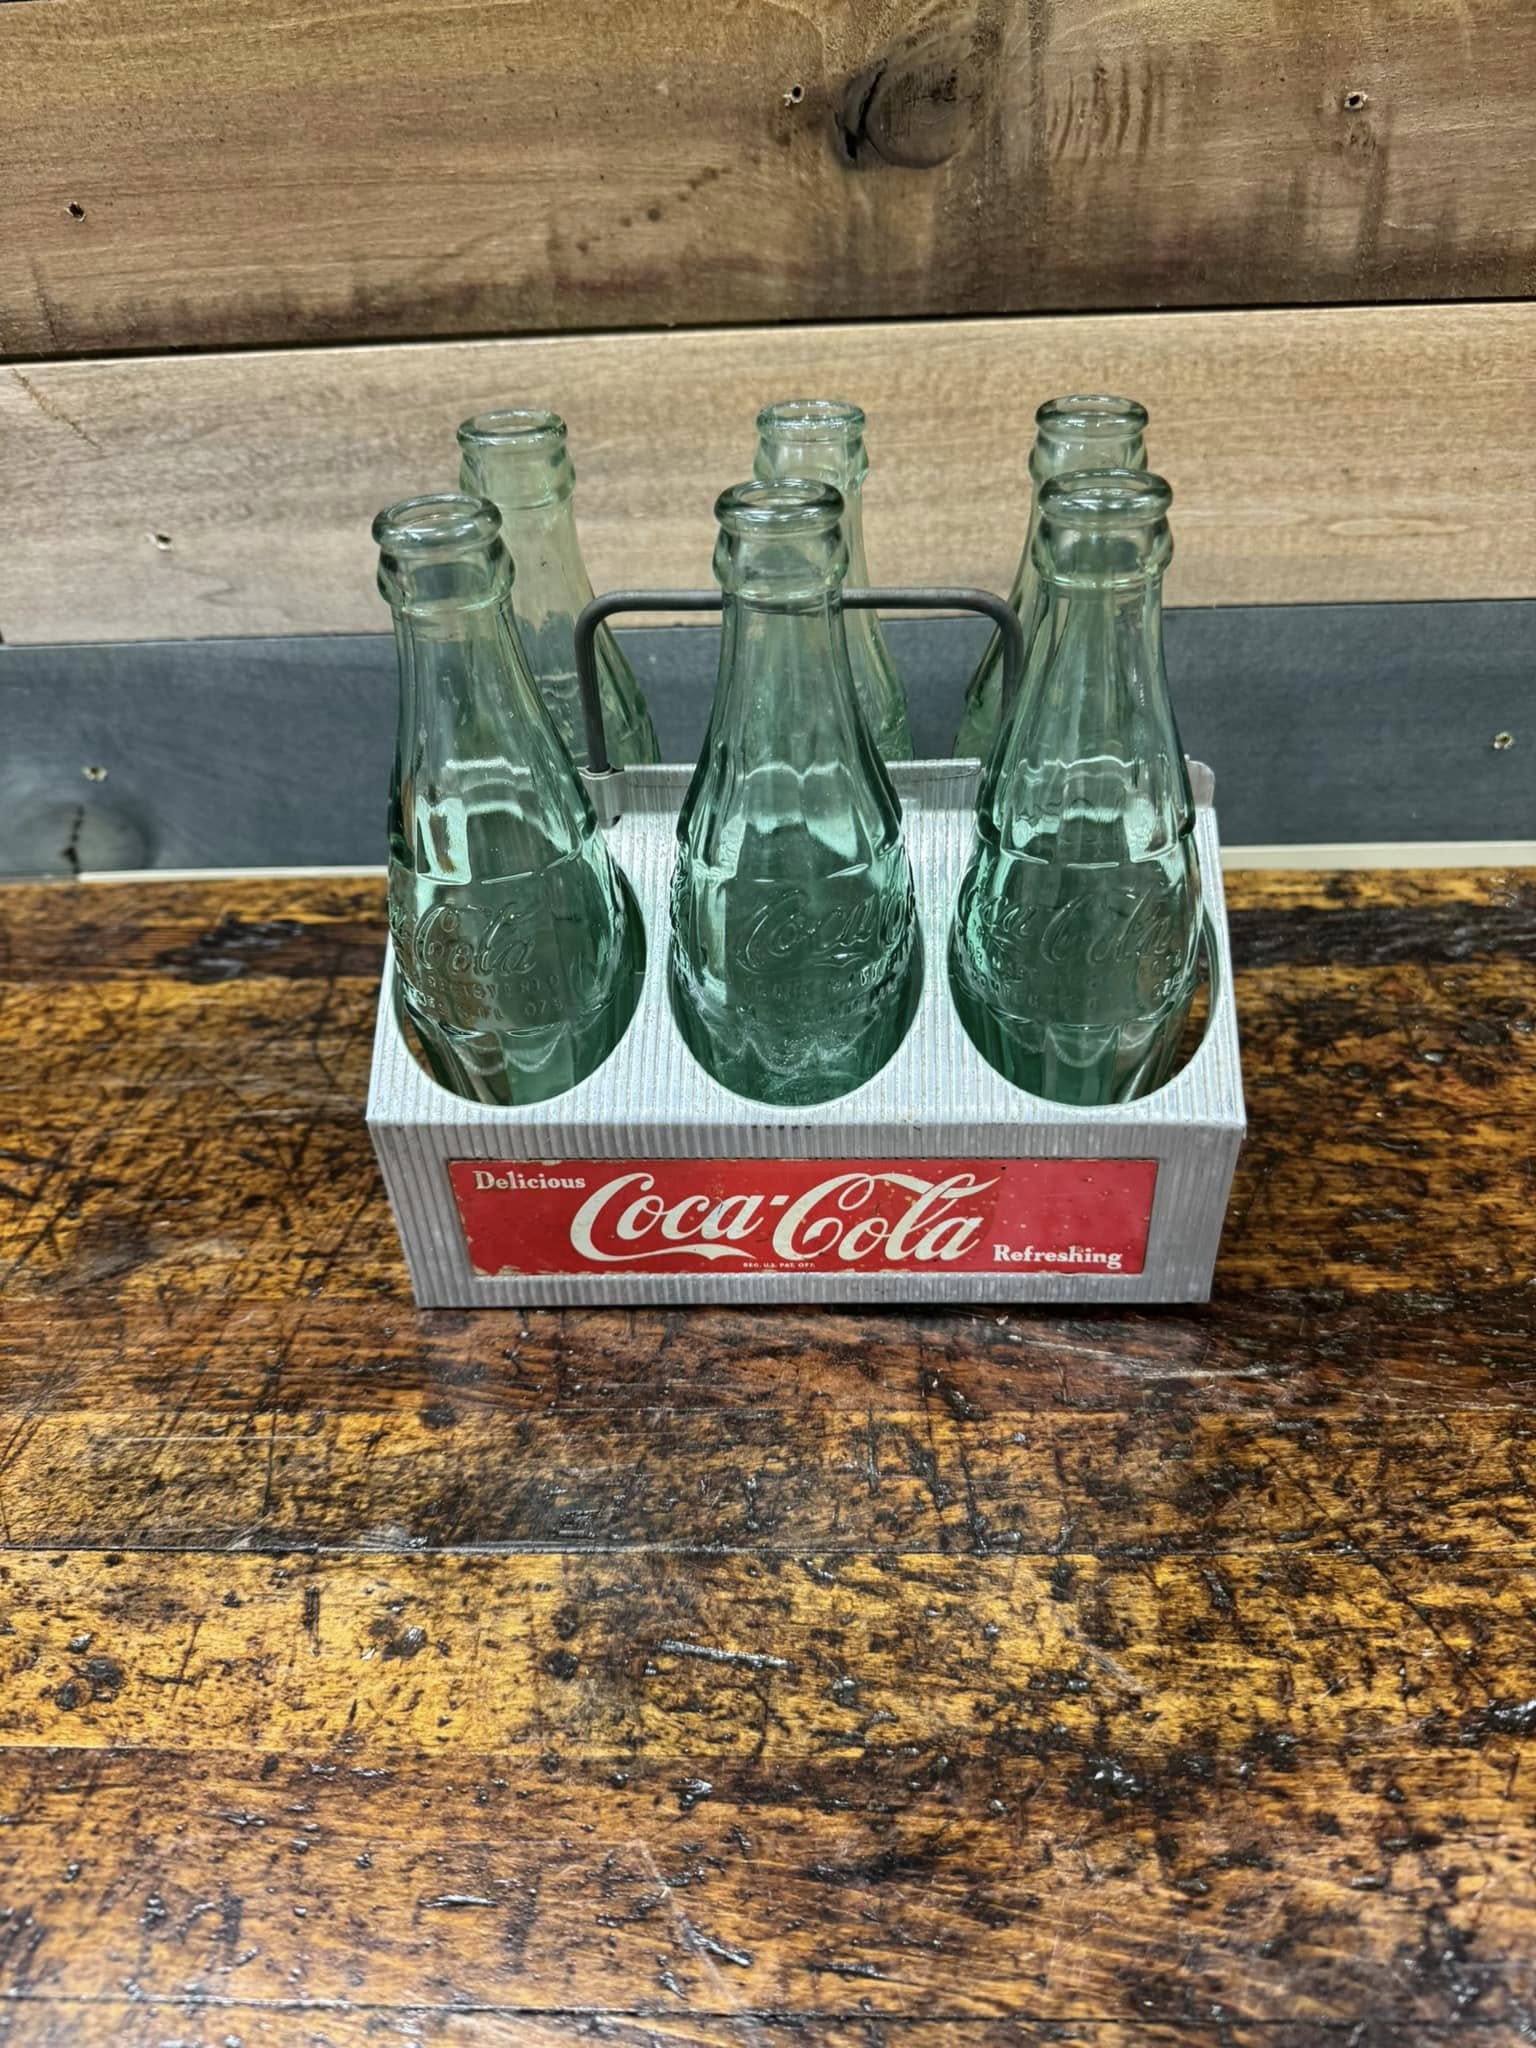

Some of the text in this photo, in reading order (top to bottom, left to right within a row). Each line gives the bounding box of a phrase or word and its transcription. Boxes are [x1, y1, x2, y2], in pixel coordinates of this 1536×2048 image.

[473, 1170, 586, 1190] Delicious
[570, 1172, 1001, 1262] Coca-Cola
[993, 1244, 1123, 1270] Refreshing
